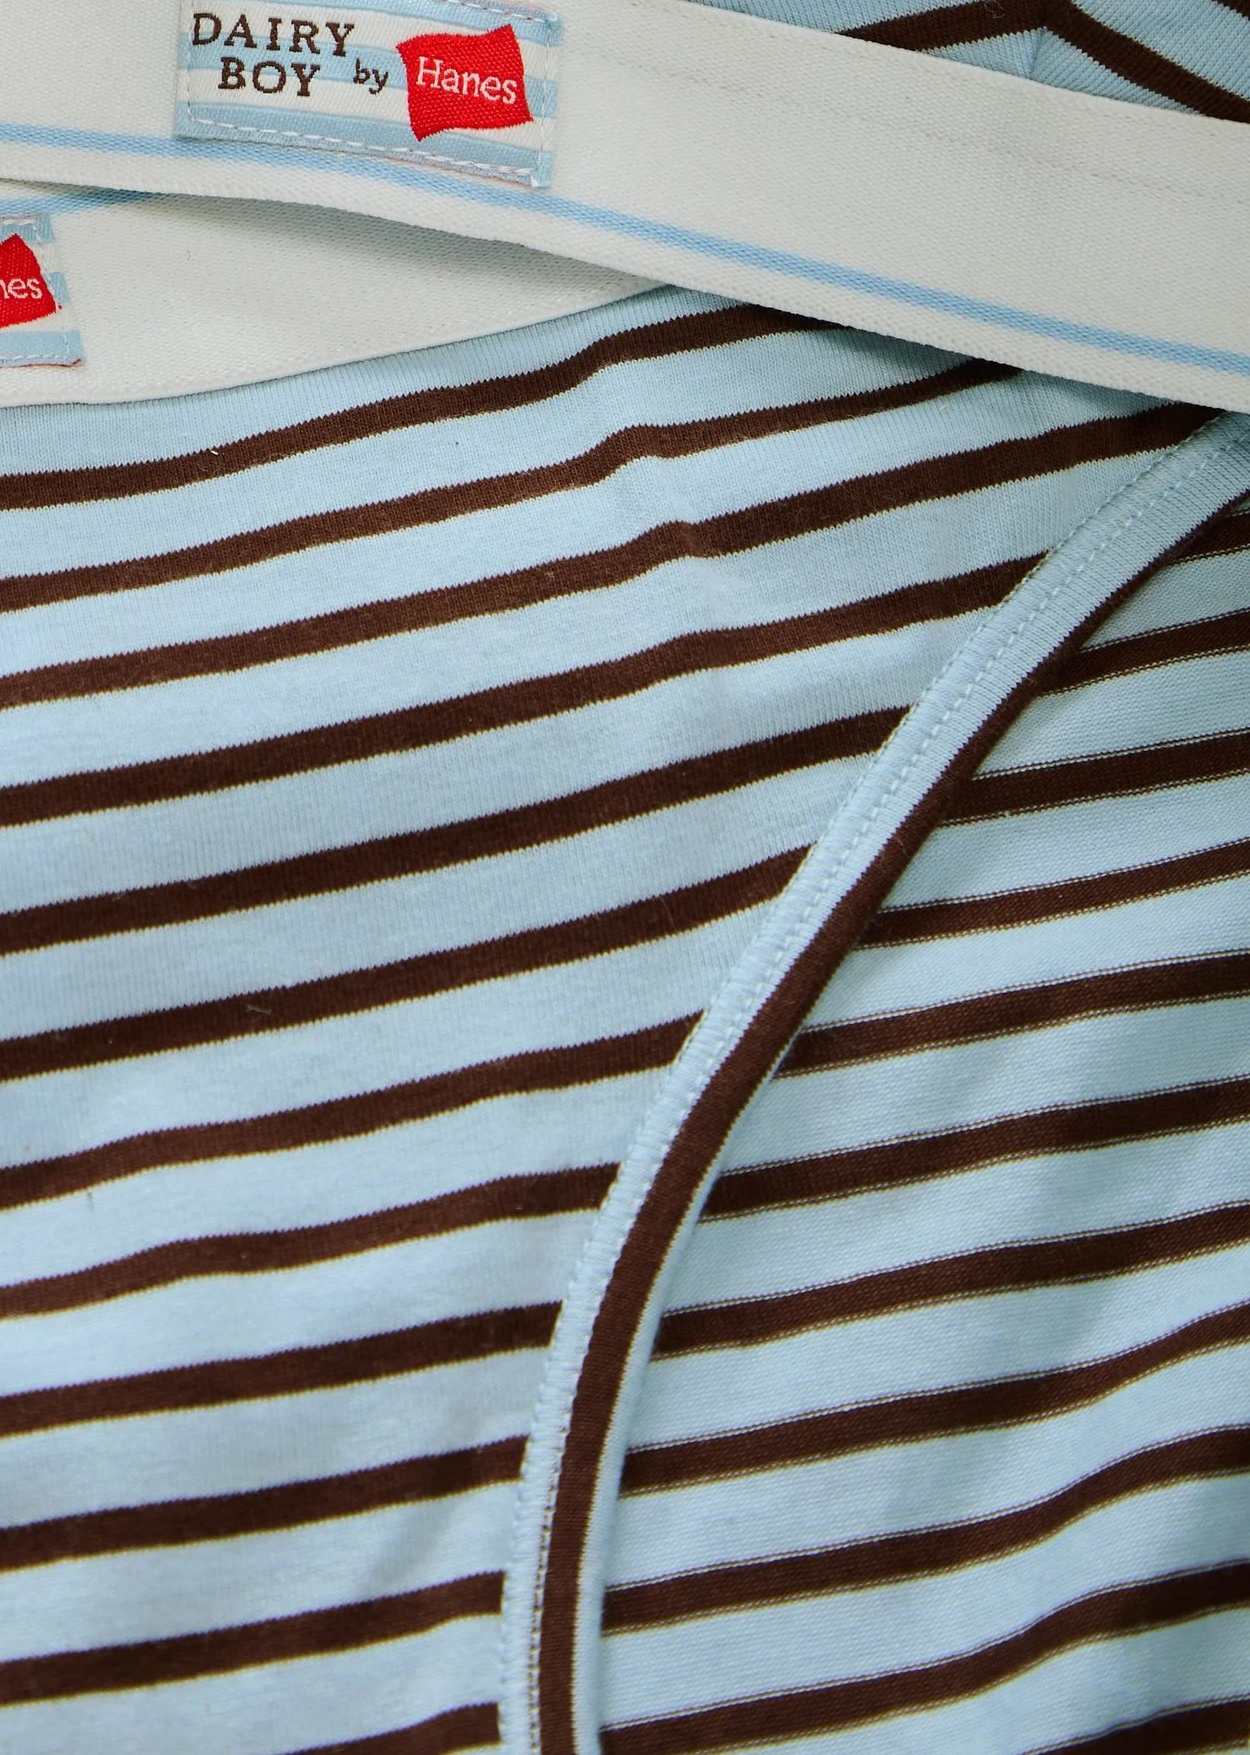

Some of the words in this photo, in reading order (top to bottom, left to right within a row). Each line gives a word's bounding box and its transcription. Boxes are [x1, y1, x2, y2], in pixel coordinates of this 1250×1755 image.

[192, 12, 355, 57] DAIRY
[218, 56, 321, 97] BOY
[353, 58, 389, 95] by
[416, 55, 518, 105] Hanes
